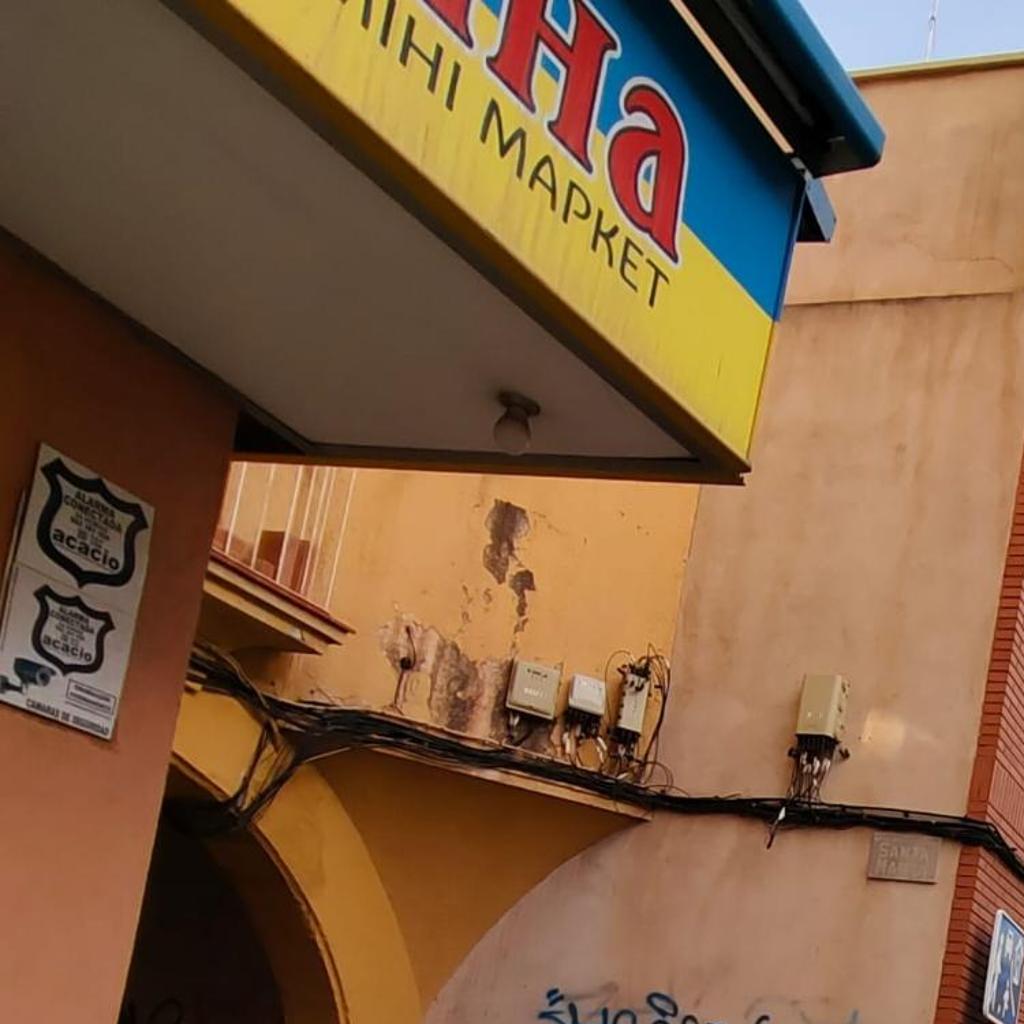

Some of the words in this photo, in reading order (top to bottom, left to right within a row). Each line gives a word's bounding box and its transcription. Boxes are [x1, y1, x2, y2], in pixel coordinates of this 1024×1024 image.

[480, 99, 670, 308] МАРКЕТ
[63, 494, 122, 534] CONECTADA
[74, 490, 116, 519] ALARMA
[53, 528, 119, 571] acacio
[43, 633, 92, 662] acacio
